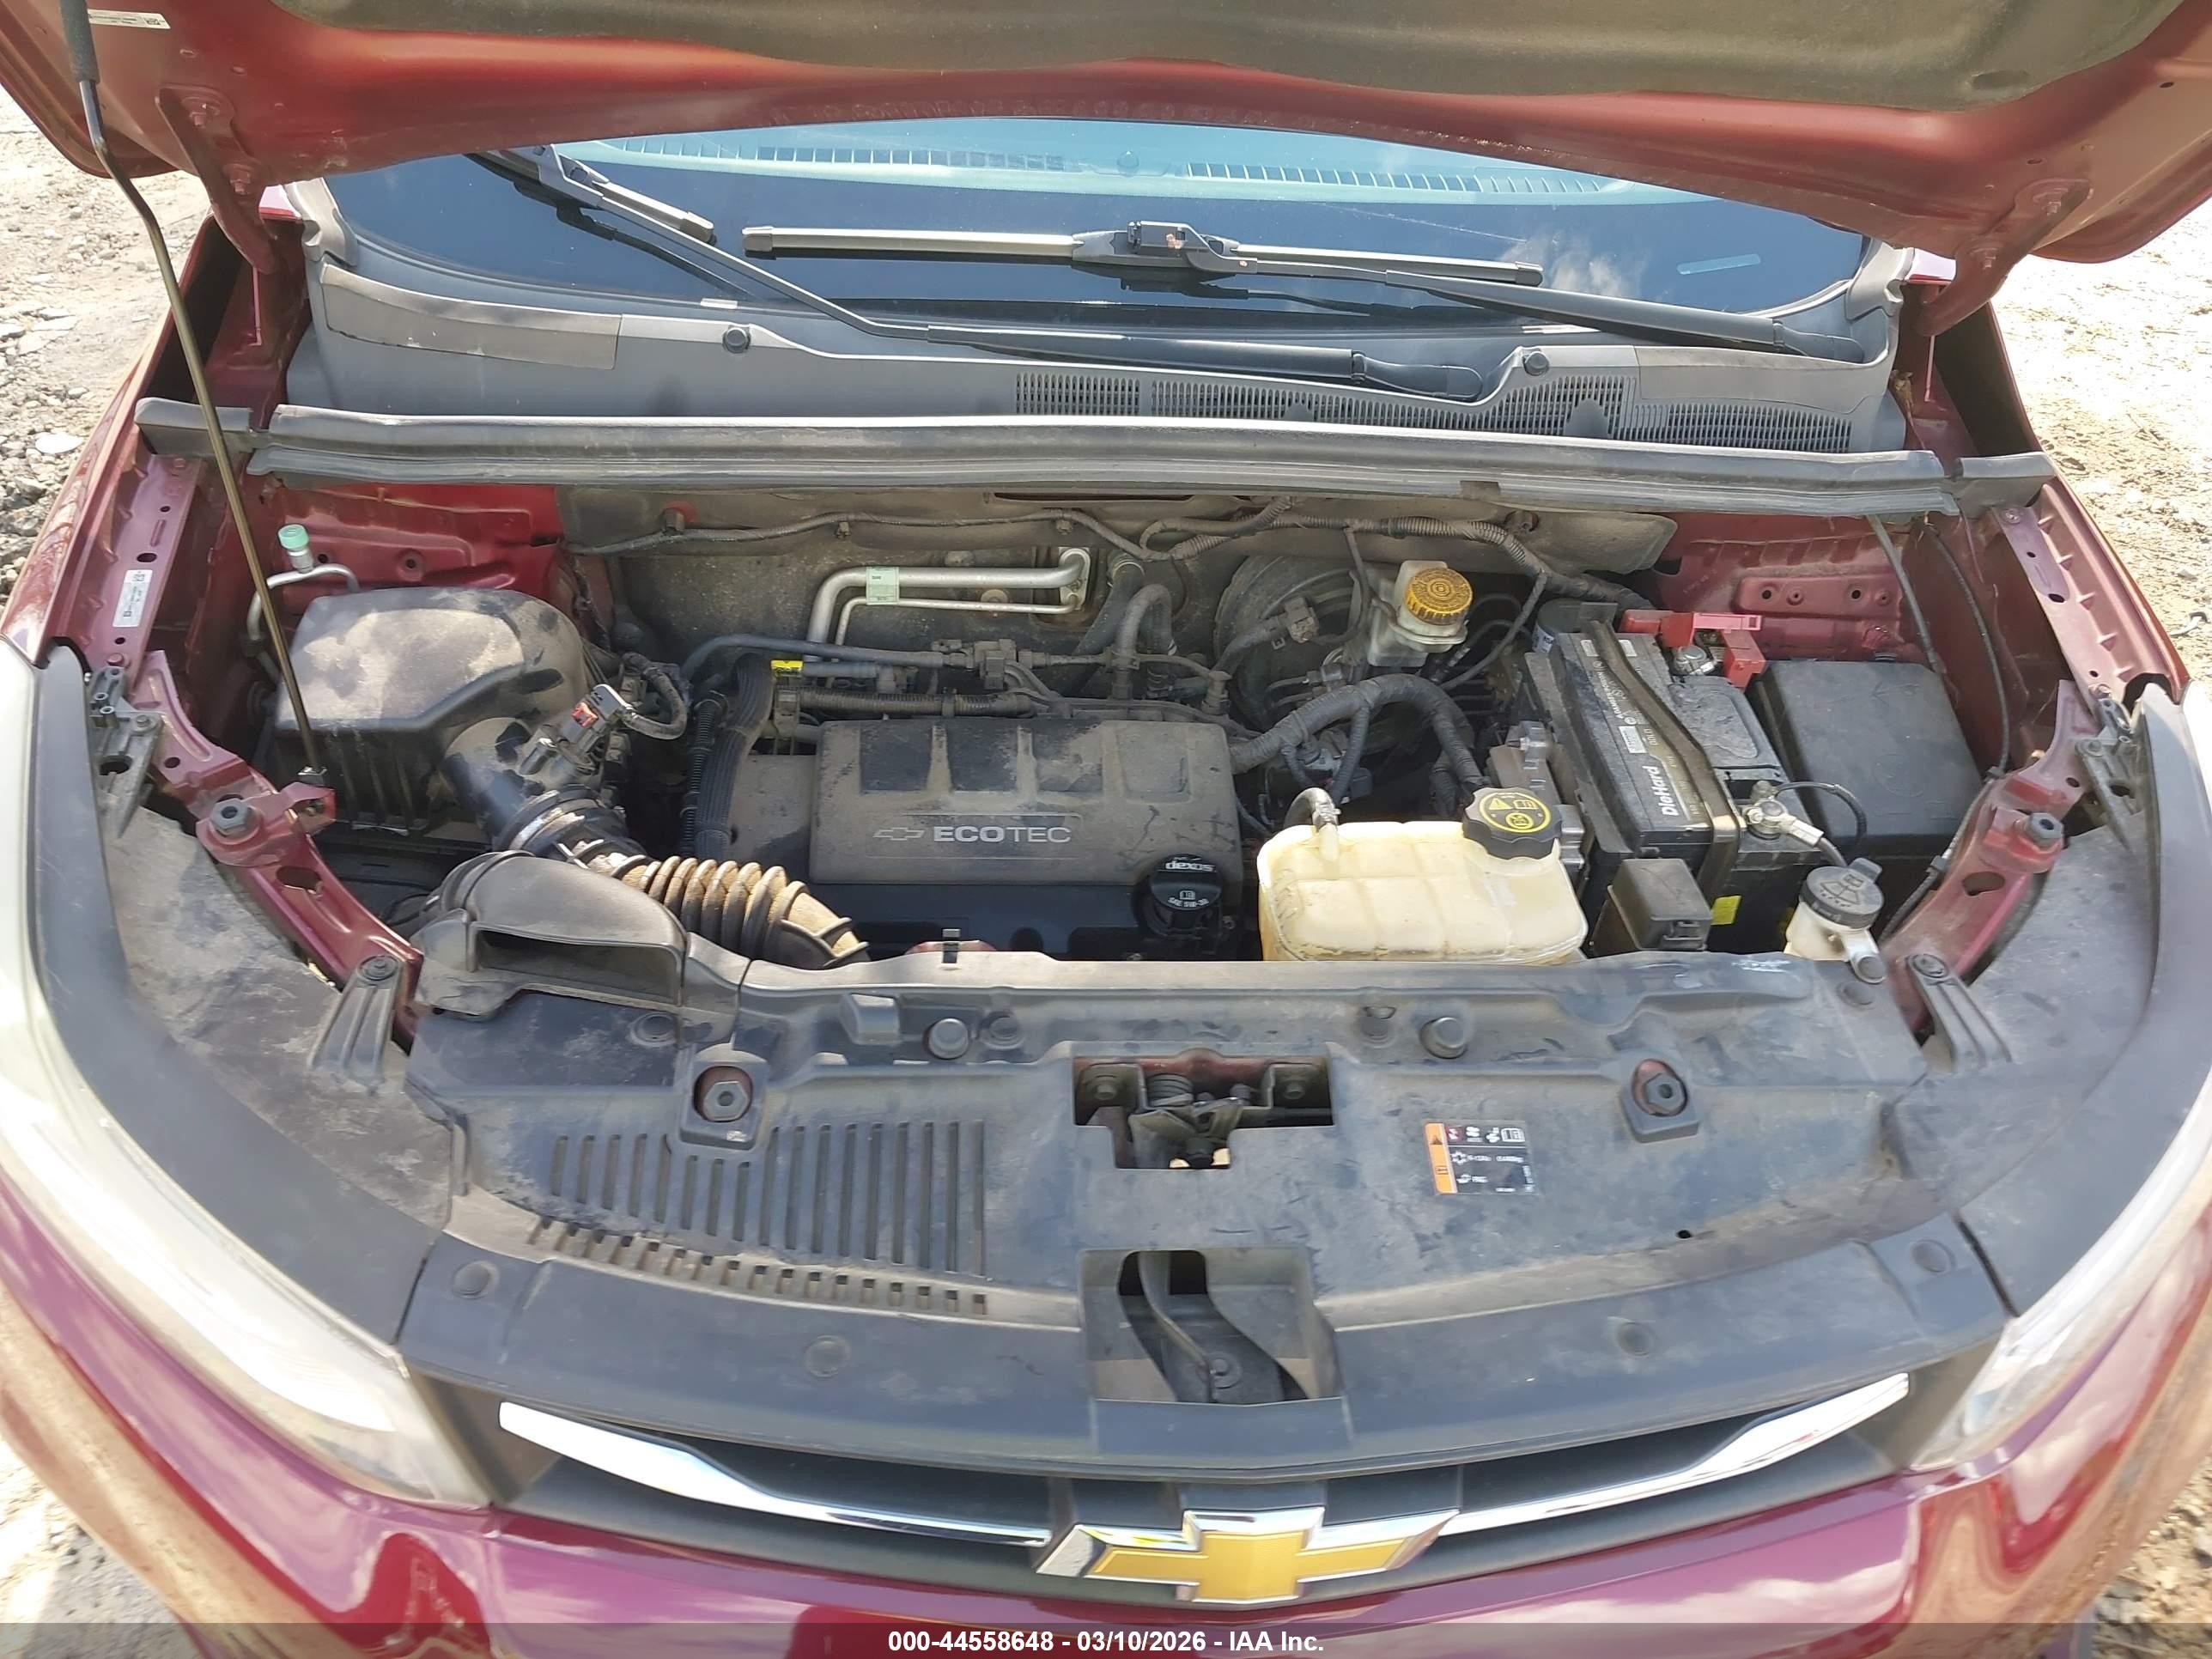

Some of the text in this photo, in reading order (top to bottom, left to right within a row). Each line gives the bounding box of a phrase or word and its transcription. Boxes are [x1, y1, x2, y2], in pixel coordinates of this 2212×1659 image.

[1642, 765, 1680, 816] DieHard
[933, 826, 1072, 843] ECOTEC
[1165, 860, 1217, 872] dexos
